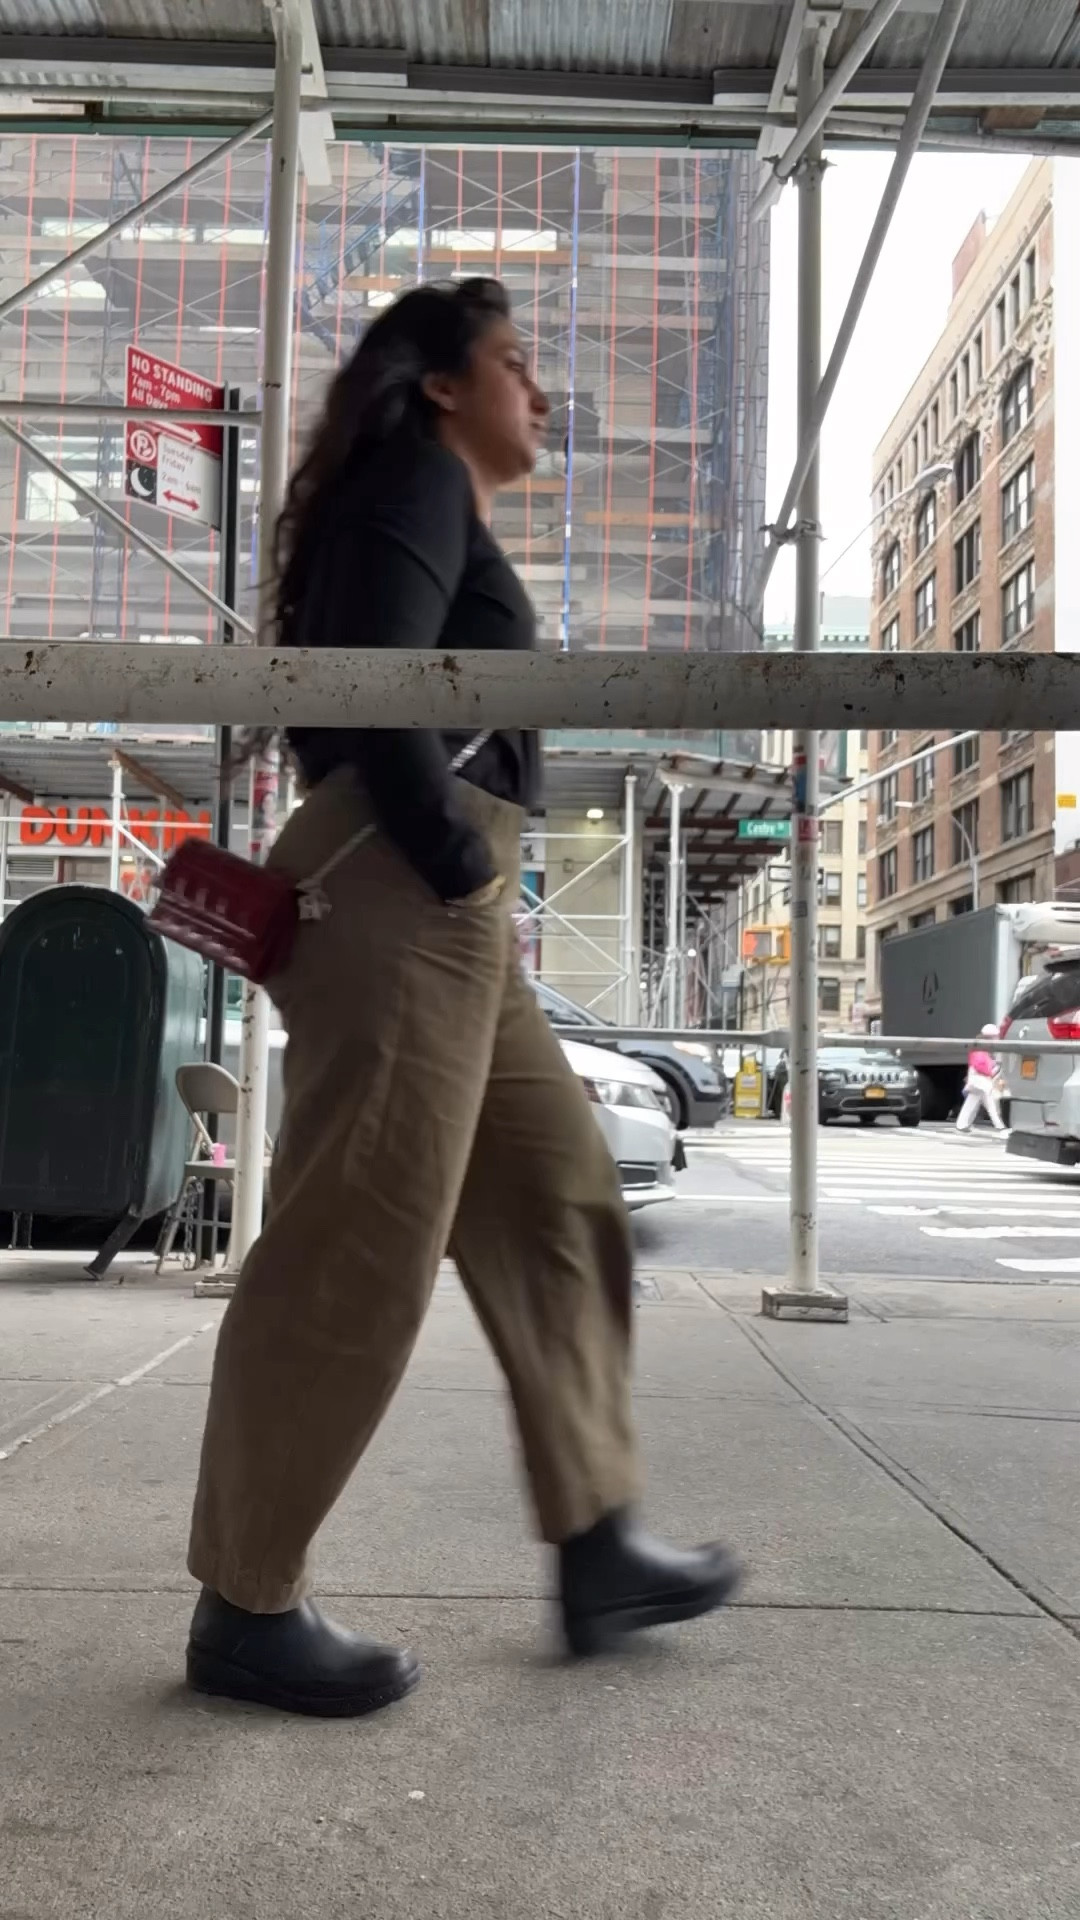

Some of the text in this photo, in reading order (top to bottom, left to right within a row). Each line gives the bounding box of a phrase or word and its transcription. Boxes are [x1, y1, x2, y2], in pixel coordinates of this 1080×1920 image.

[131, 354, 212, 403] NO STANDING
[132, 371, 152, 391] 7am
[160, 384, 181, 404] 7pm
[131, 388, 144, 402] All
[161, 454, 186, 473] Friday
